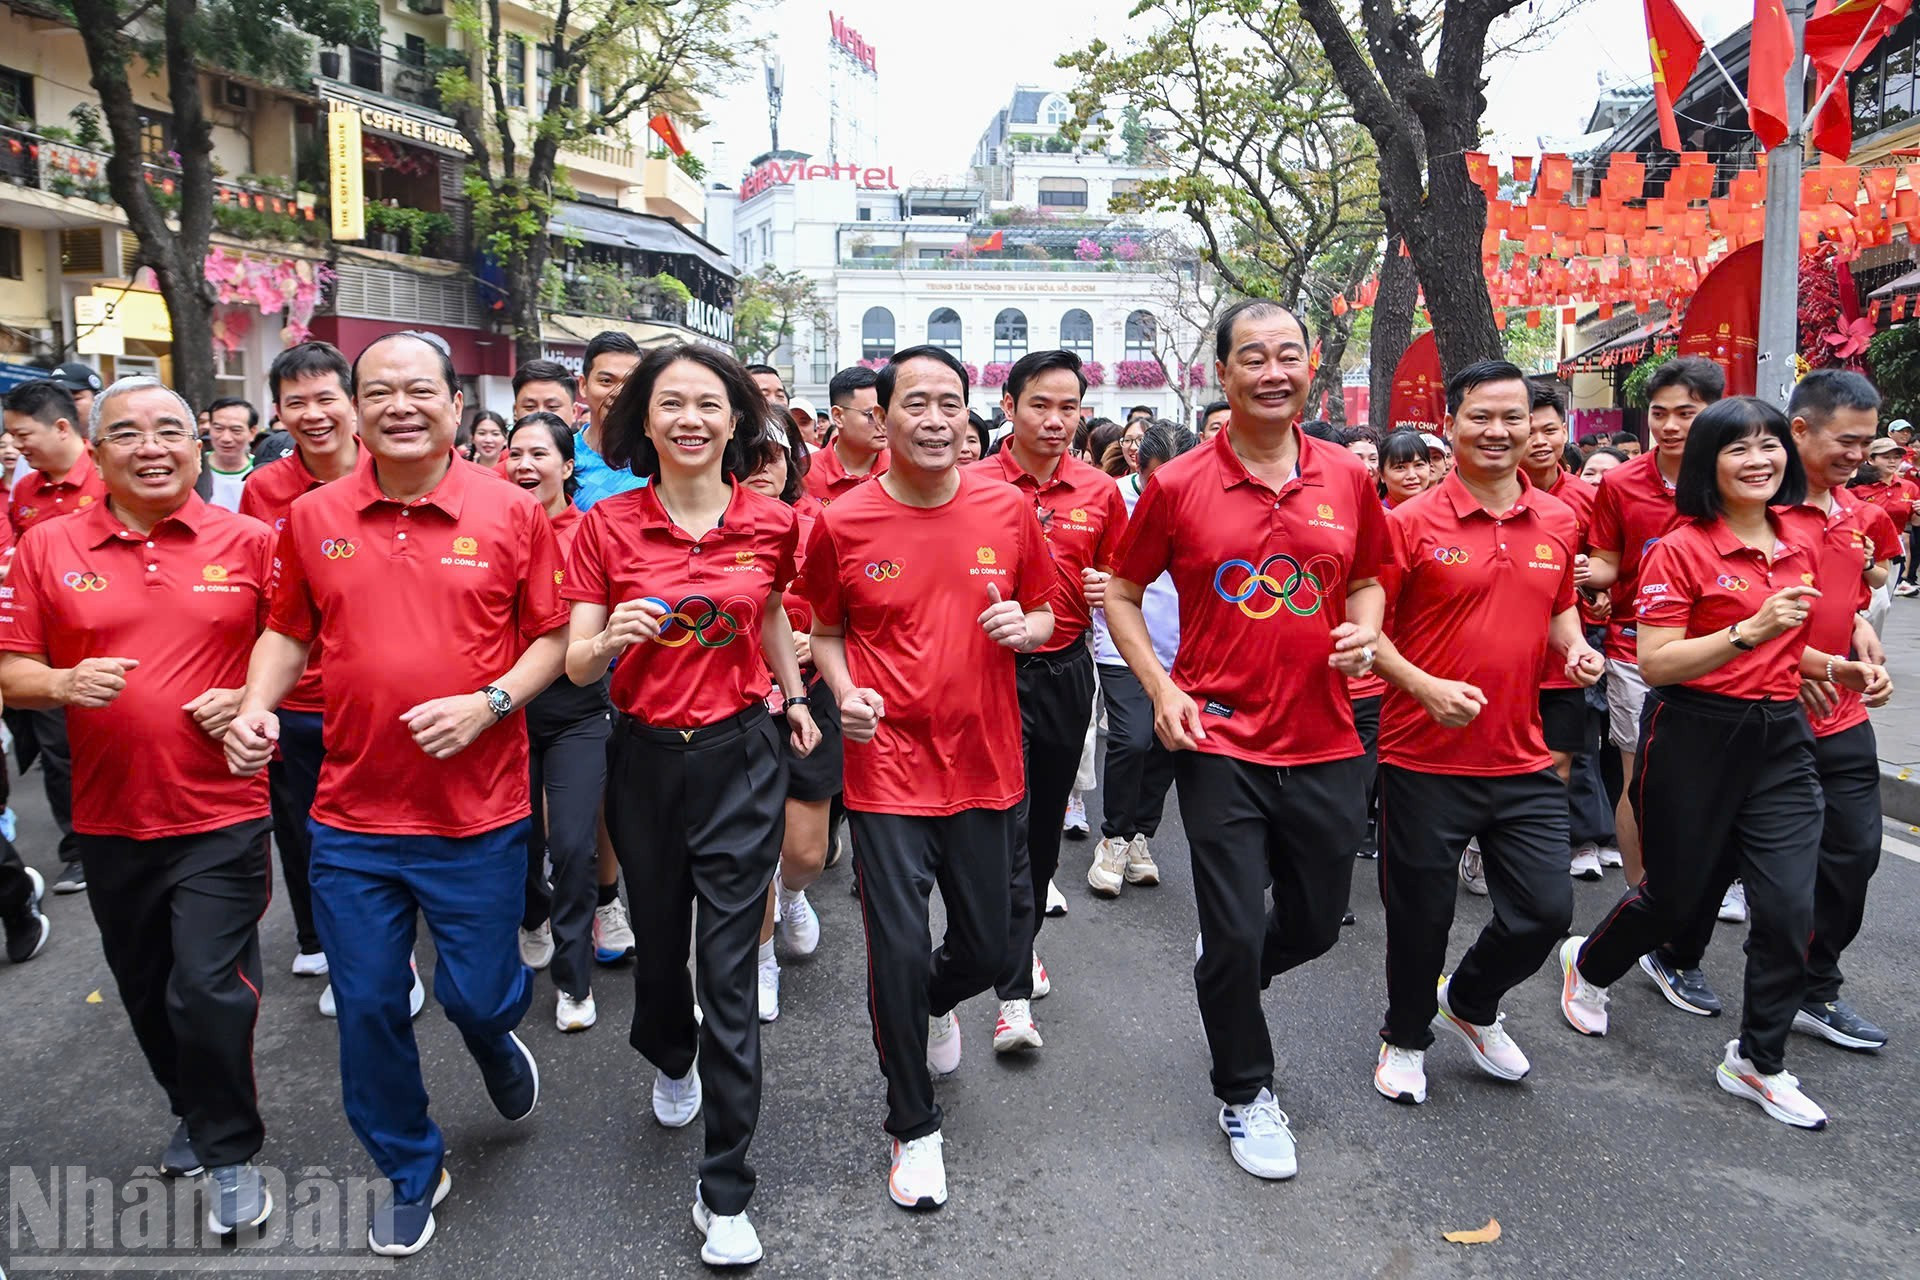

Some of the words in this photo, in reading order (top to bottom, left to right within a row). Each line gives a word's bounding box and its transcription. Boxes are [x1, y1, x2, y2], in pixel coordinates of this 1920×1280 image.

[361, 107, 424, 139] COFFEE
[424, 125, 474, 155] HOUSE
[340, 164, 349, 204] COFFEE
[769, 161, 899, 190] Viettel
[955, 282, 972, 290] TÂM
[974, 282, 1002, 291] THÔNG
[687, 298, 734, 342] BALCONY
